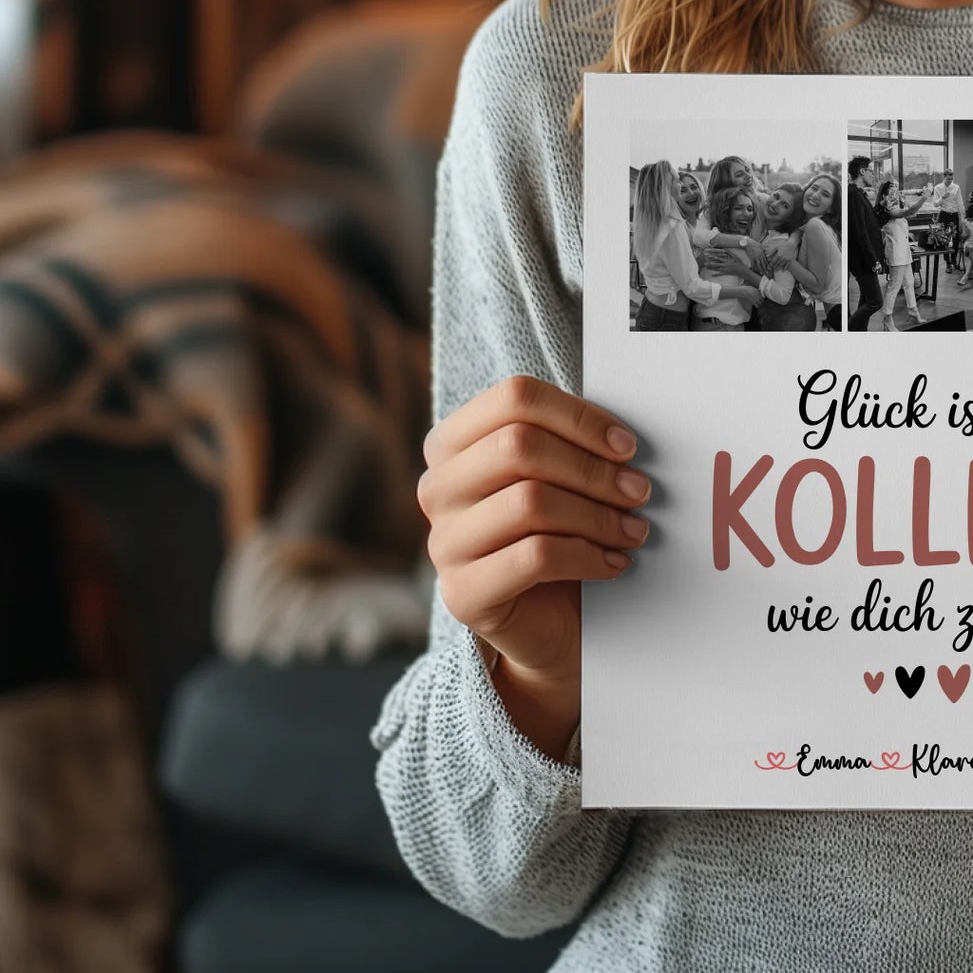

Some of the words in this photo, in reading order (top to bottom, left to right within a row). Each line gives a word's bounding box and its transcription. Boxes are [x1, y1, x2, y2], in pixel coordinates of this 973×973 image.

[797, 369, 937, 450] Glück
[767, 595, 840, 633] wie
[850, 578, 945, 633] dich
[796, 743, 872, 777] Emma
